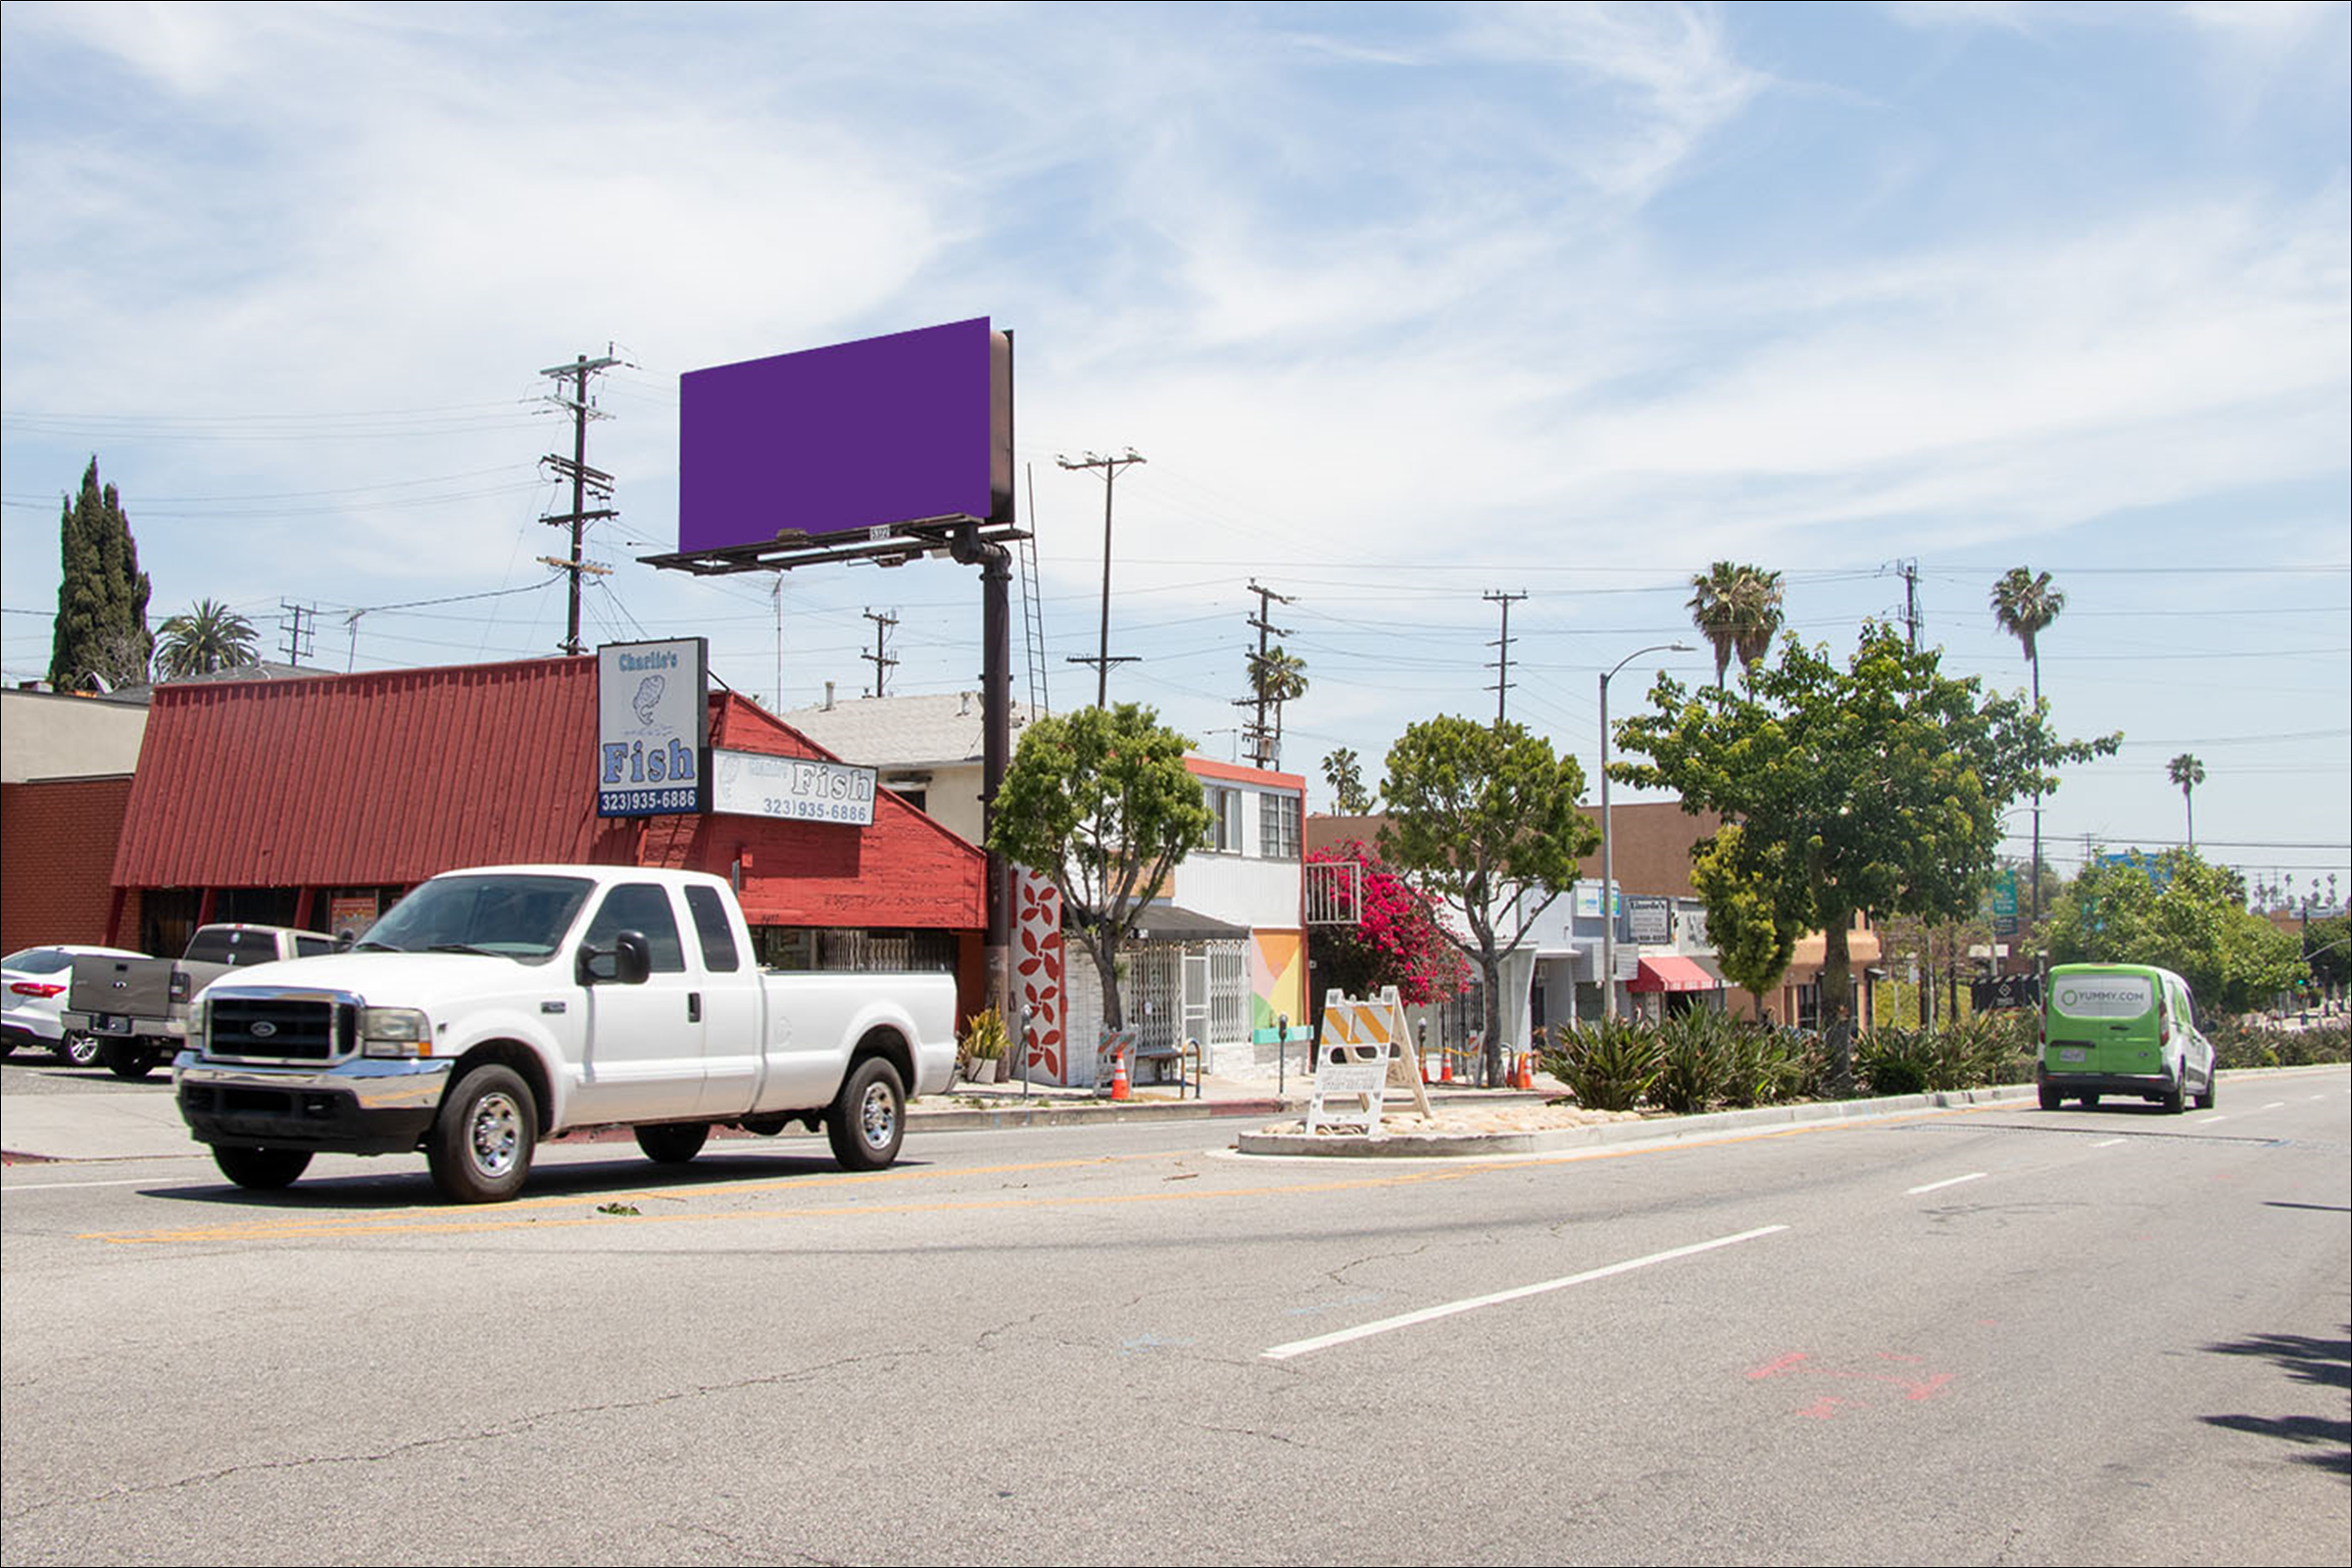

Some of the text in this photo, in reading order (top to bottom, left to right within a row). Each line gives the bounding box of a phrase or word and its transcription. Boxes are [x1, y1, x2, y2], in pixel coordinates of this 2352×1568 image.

[619, 651, 677, 672] Charlie's
[603, 738, 695, 783] Fish
[792, 762, 871, 802] Fish
[602, 790, 696, 810] 323)935-6886
[763, 798, 866, 821] 323)935-6886
[2079, 992, 2143, 1002] YUMMY.COM
